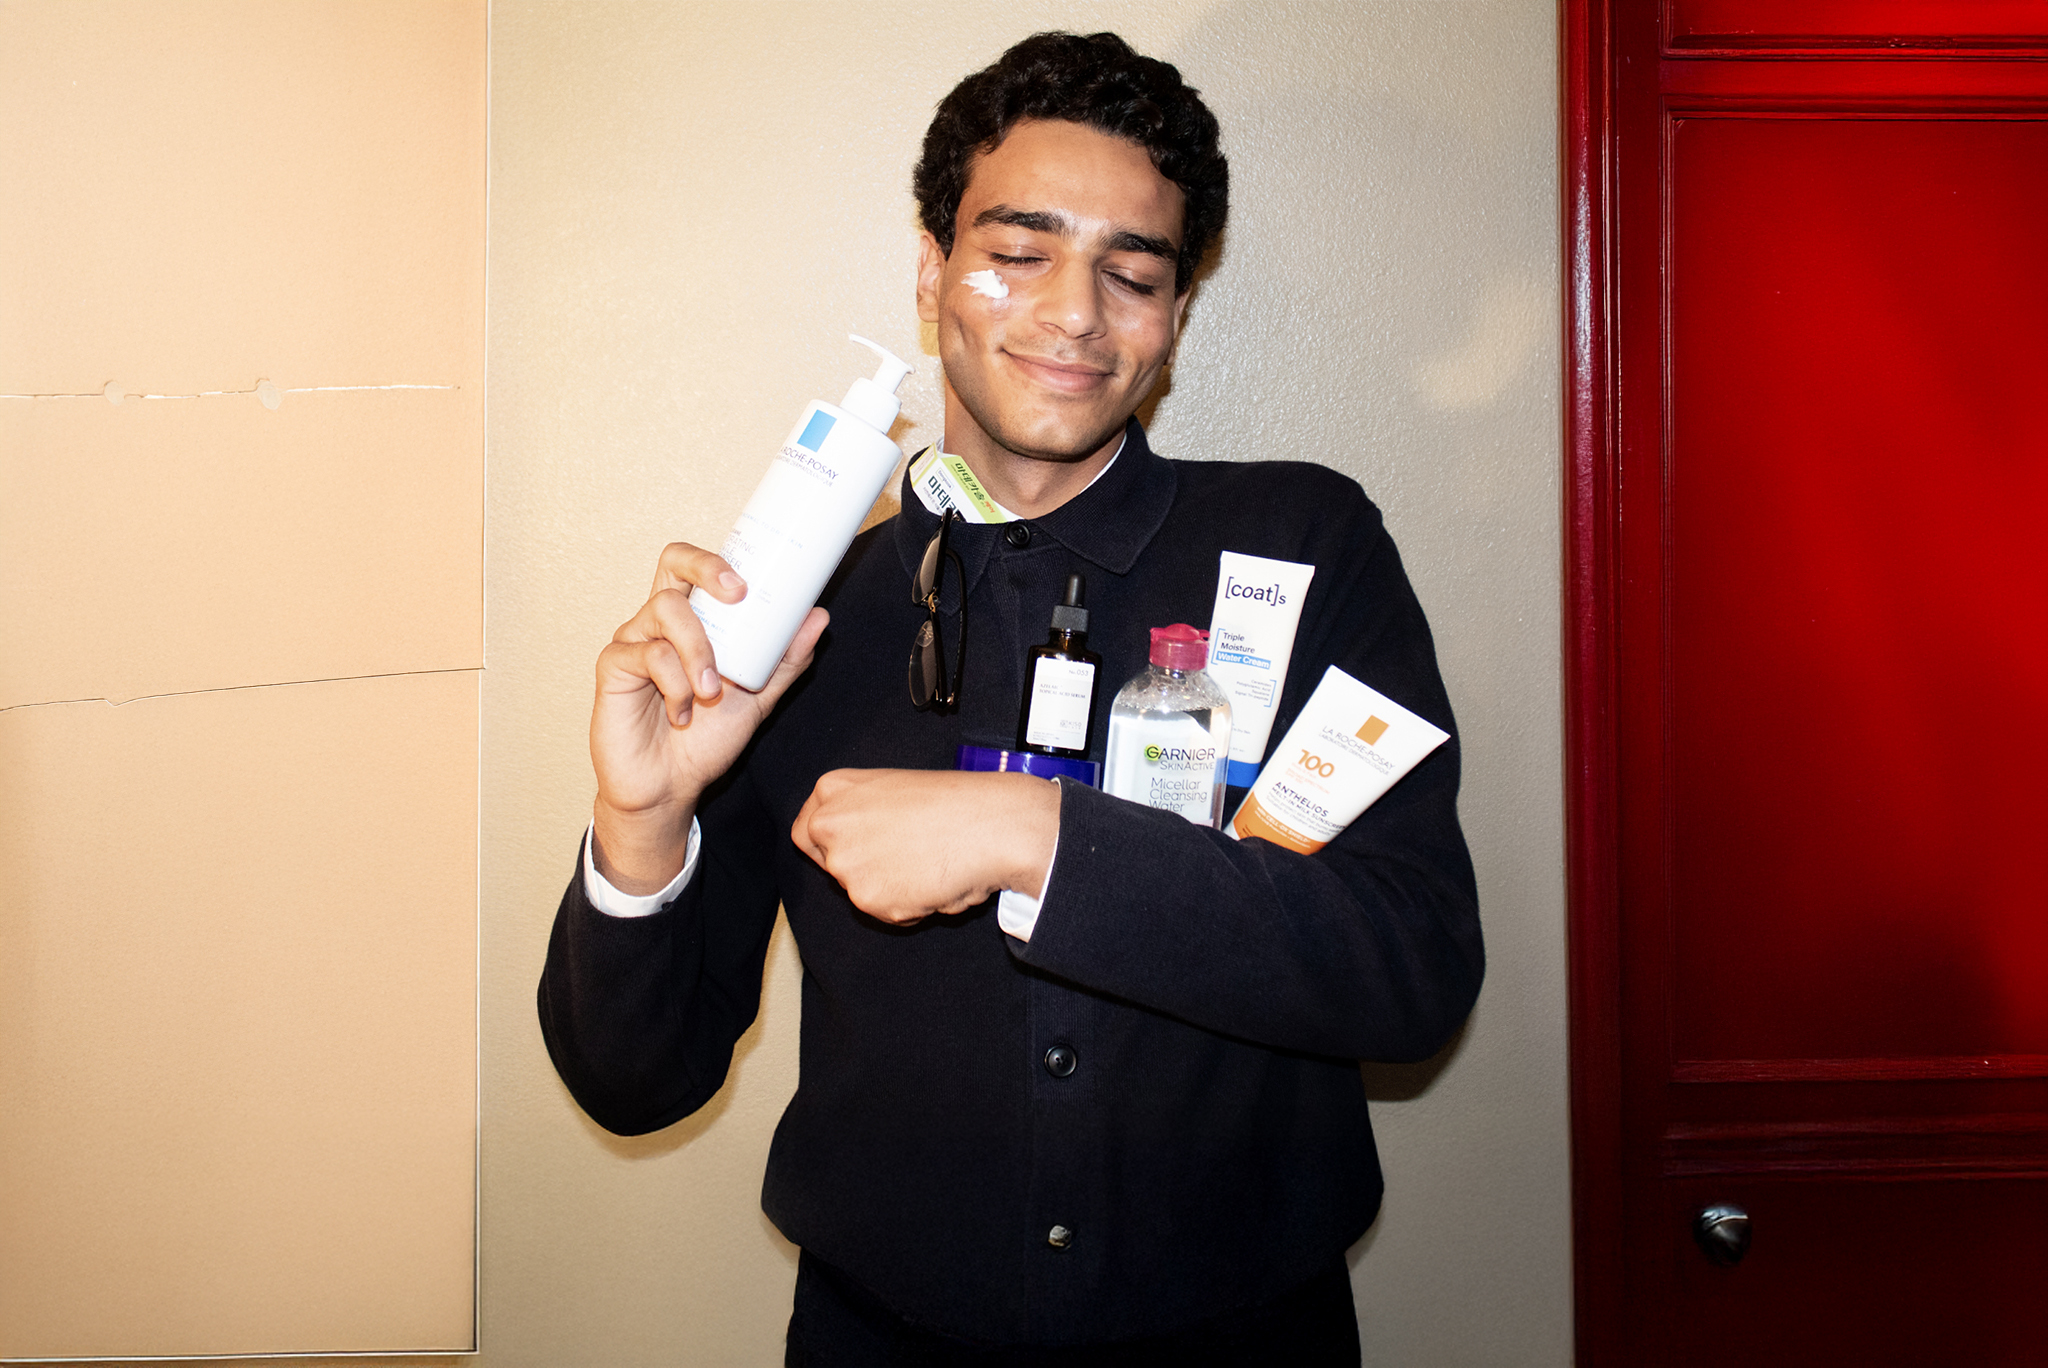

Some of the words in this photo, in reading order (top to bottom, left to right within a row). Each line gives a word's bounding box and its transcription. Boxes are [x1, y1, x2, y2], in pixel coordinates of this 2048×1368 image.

[1223, 632, 1245, 642] Triple
[1221, 642, 1256, 654] Moisture
[1217, 652, 1241, 664] Water
[1242, 656, 1270, 669] Cream
[1146, 746, 1215, 761] GARNIER
[1322, 725, 1334, 735] LA
[1335, 731, 1395, 770] ROCHE-POSAY
[1298, 749, 1335, 778] 100
[1151, 777, 1201, 791] Micellar
[1150, 789, 1208, 802] Cleansing
[1272, 787, 1294, 806] MELT-IN
[1297, 804, 1309, 814] MILK
[1276, 782, 1329, 817] ANTHELIOS
[1149, 800, 1185, 812] Water
